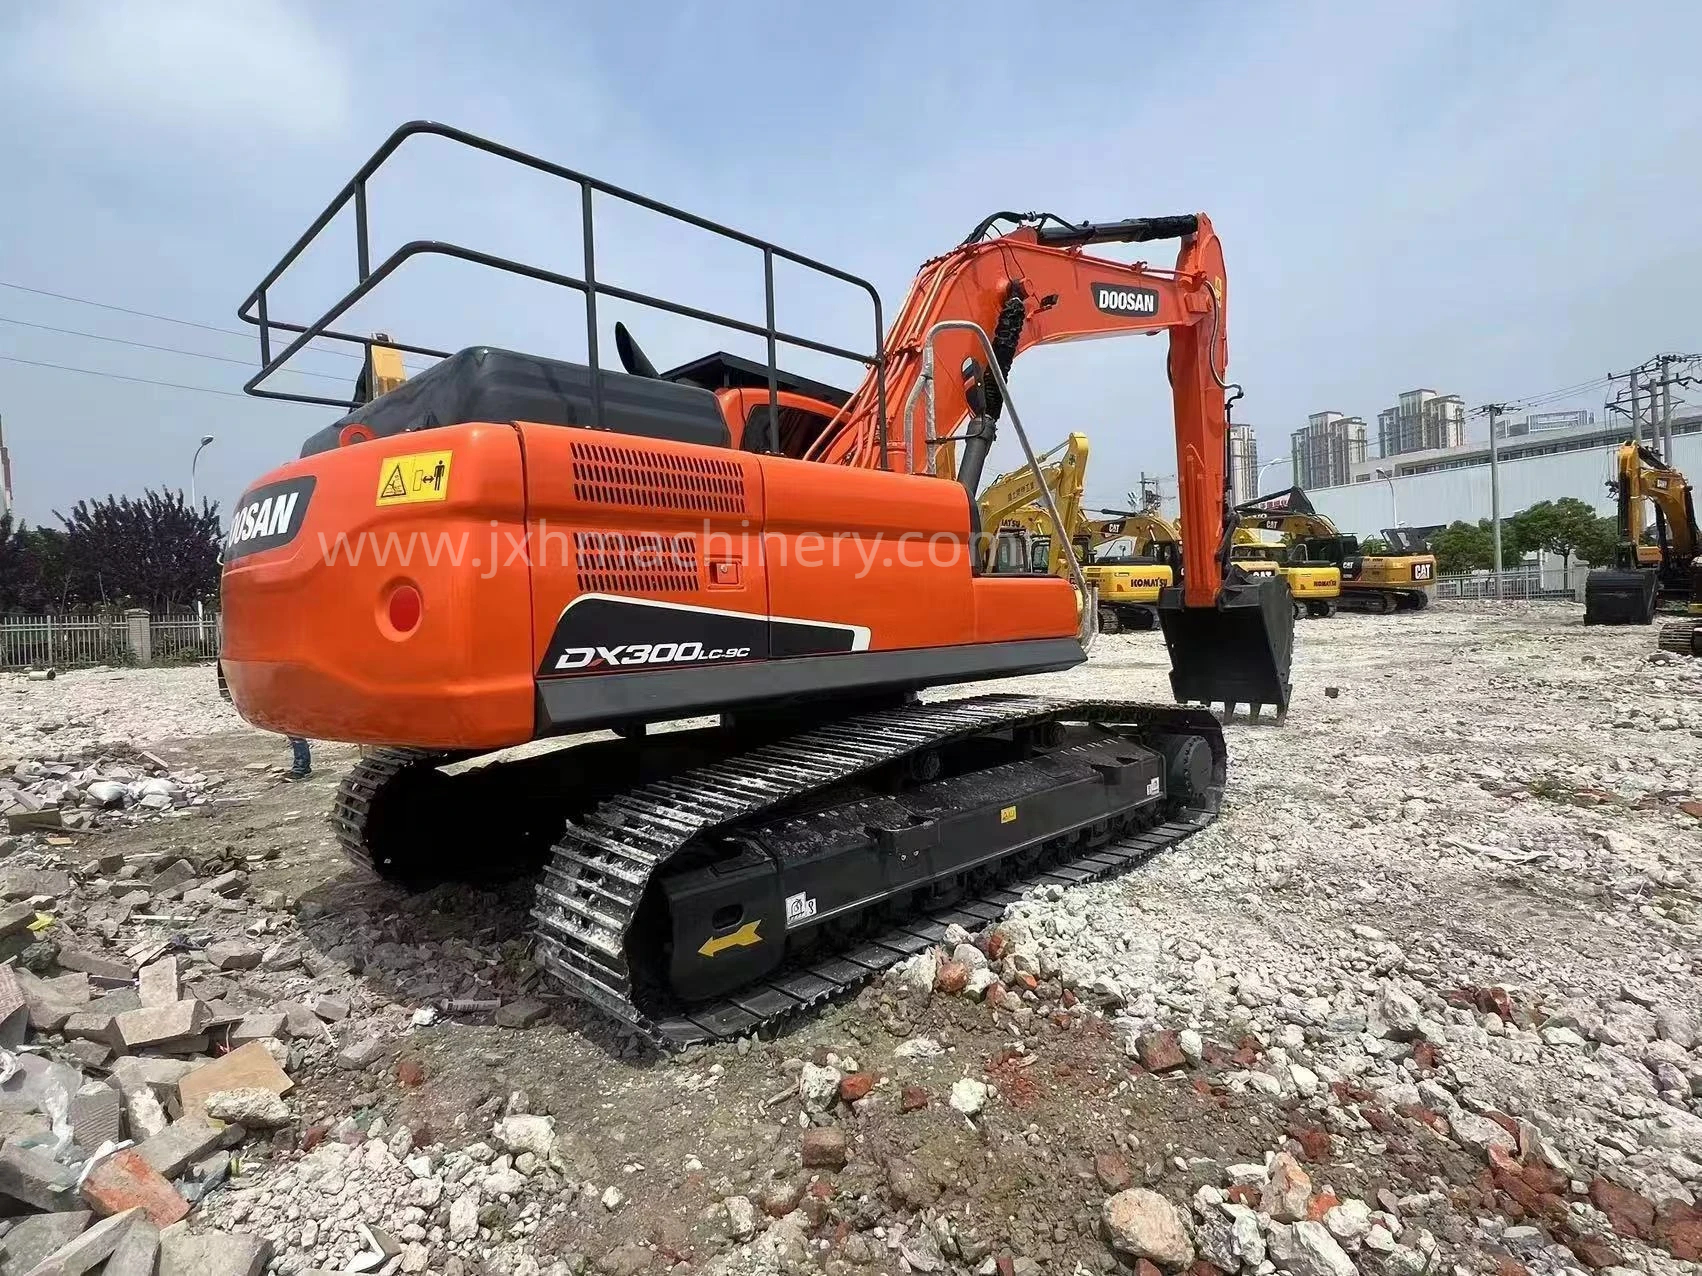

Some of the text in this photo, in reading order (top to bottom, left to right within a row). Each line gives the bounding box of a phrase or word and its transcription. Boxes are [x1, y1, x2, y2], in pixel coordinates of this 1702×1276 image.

[1099, 290, 1154, 312] DOOSAN
[228, 492, 299, 548] OOSAN
[1266, 520, 1278, 529] CAT
[1108, 523, 1120, 533] CAT
[1342, 561, 1354, 569] CAT
[1414, 564, 1431, 580] CAT
[1130, 576, 1168, 588] KOMATSU
[555, 642, 750, 669] DX300LC-9C
